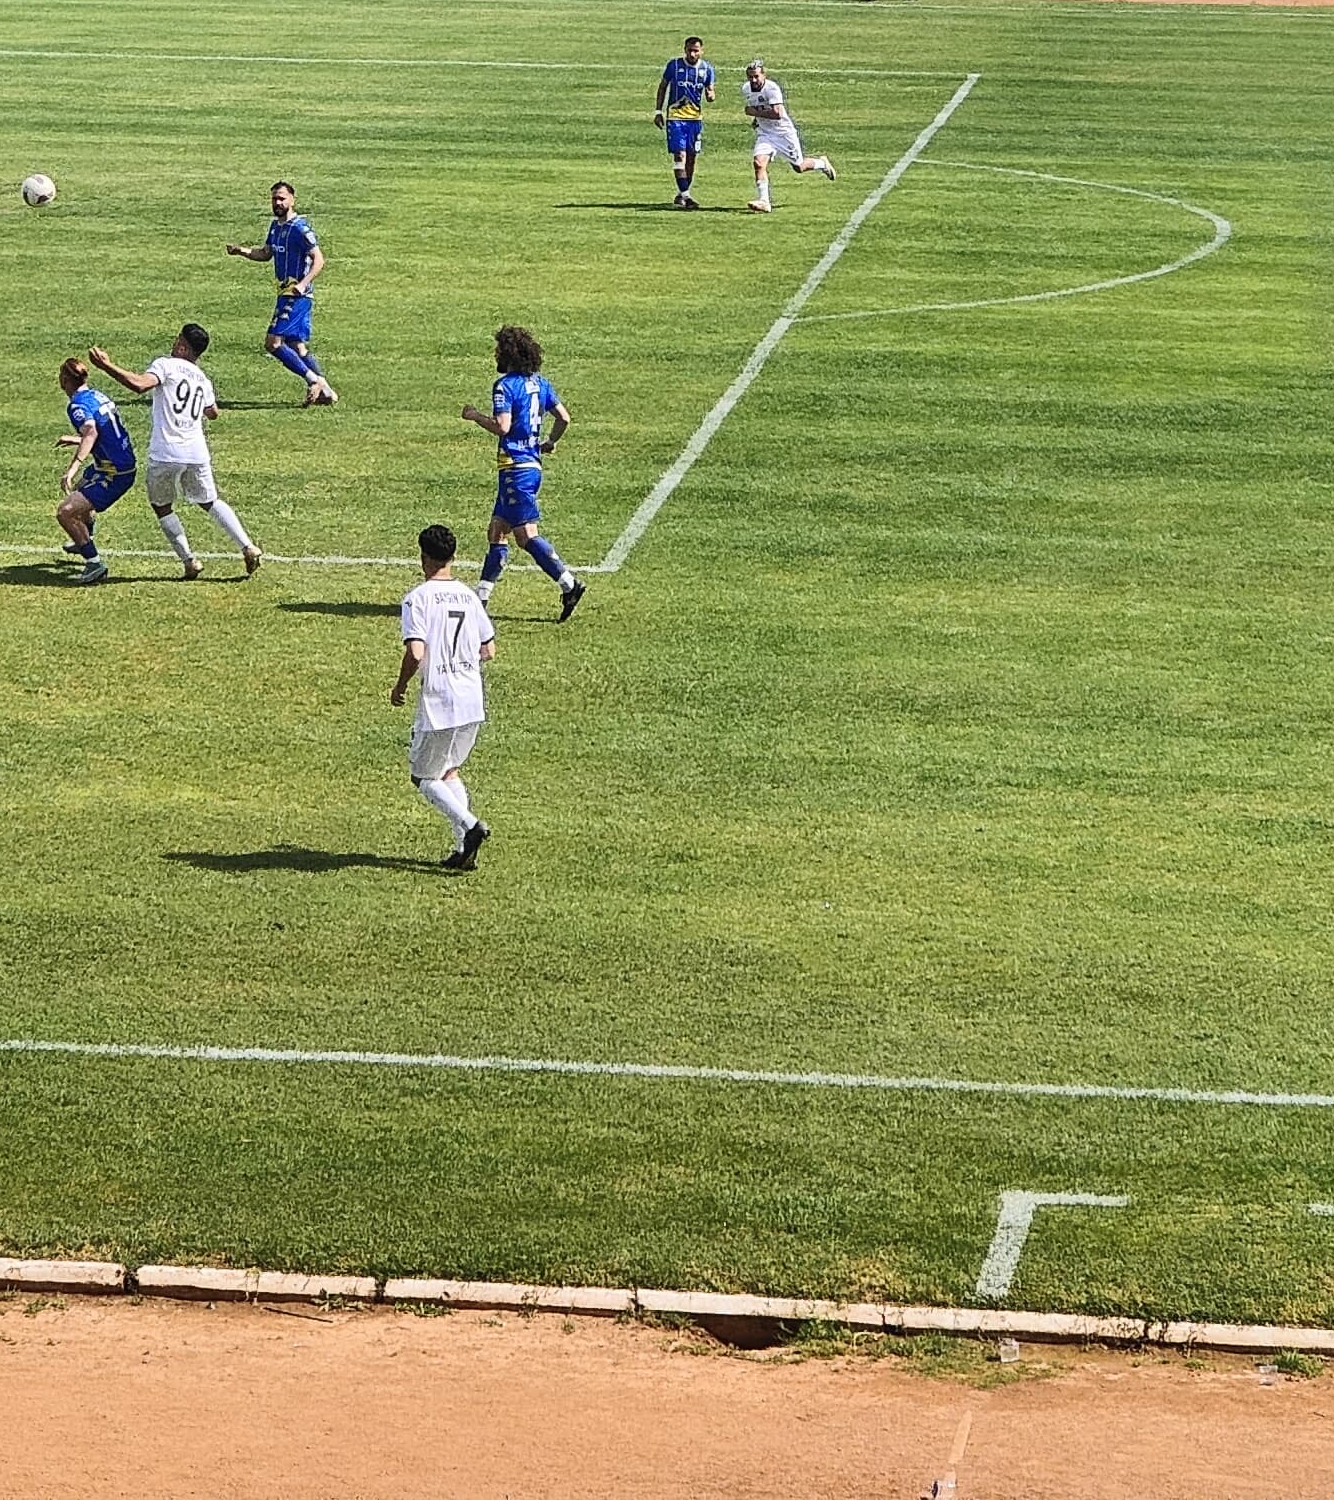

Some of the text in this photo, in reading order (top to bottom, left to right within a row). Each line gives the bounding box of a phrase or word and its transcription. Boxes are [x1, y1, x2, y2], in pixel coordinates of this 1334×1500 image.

[173, 378, 204, 421] 90
[529, 393, 543, 433] 4
[447, 610, 465, 658] 7
